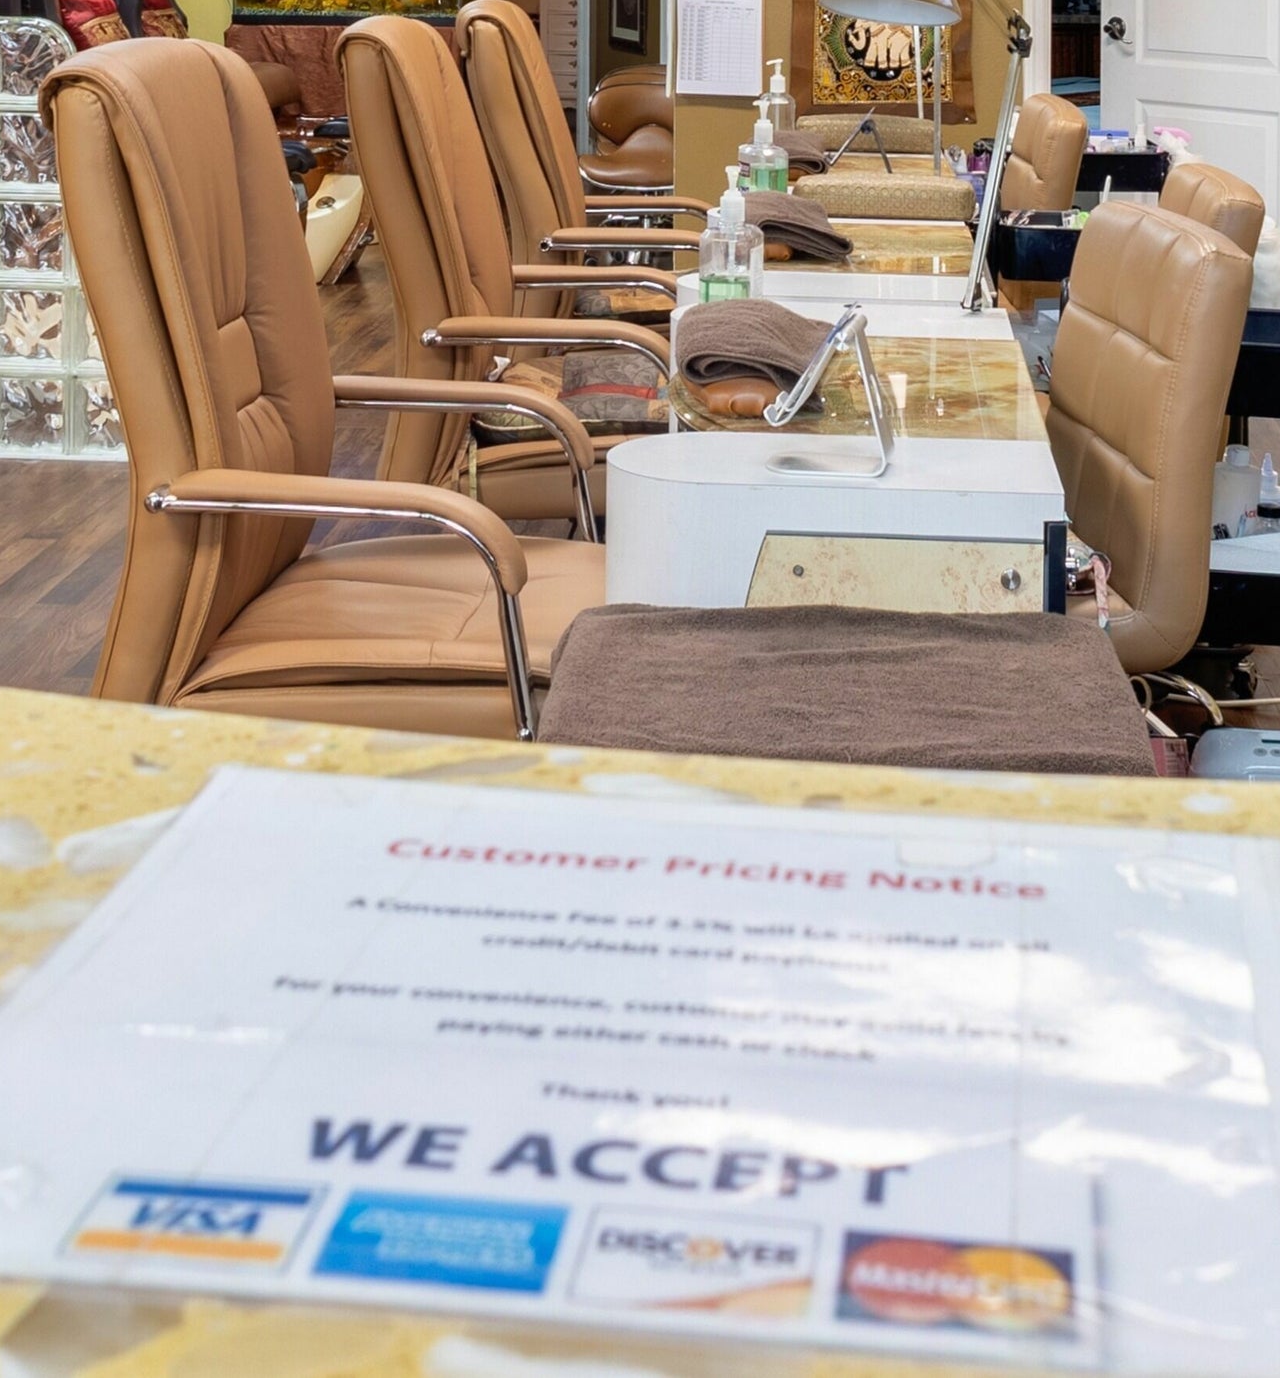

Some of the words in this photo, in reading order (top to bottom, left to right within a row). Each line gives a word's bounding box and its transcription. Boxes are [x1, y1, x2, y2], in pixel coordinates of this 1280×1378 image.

[386, 836, 648, 872] Customer
[664, 856, 849, 890] Pricing
[868, 870, 1046, 900] Notice
[346, 896, 368, 910] A
[376, 896, 559, 923] Convenience
[481, 933, 660, 956] credit/debit
[274, 975, 322, 990] For
[332, 981, 403, 996] your
[436, 1018, 543, 1040] paying
[553, 1024, 648, 1043] either
[657, 1031, 730, 1049] cash
[542, 1081, 642, 1105] Thank
[307, 1116, 468, 1172] WE
[489, 1132, 911, 1205] ACCEPT
[129, 1198, 262, 1237] VISA
[597, 1226, 799, 1265] DISCOVER
